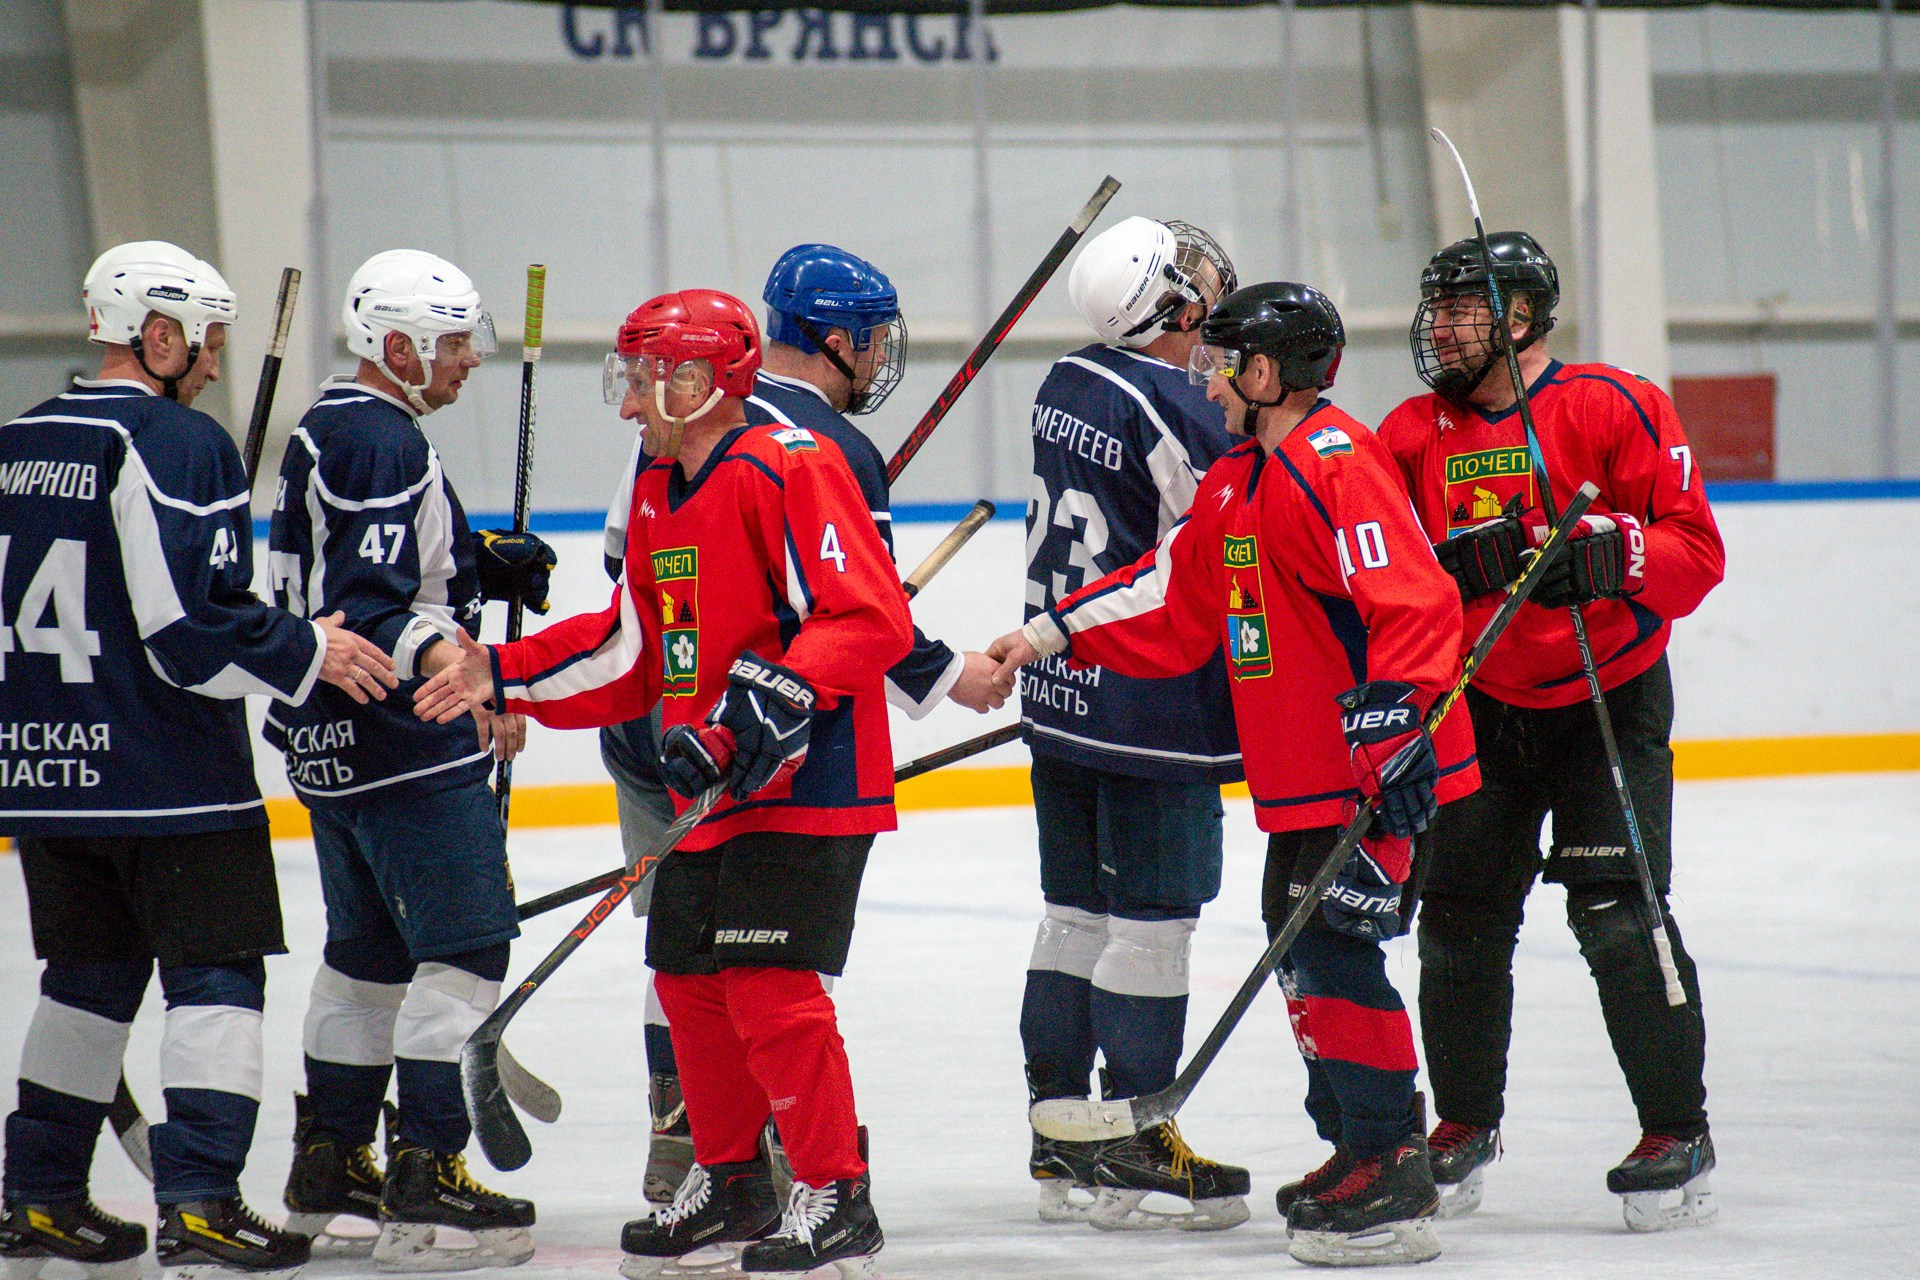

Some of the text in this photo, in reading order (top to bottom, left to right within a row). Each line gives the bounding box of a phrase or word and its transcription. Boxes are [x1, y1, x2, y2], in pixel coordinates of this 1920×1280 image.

[149, 289, 187, 299] BAUER
[374, 305, 410, 313] BAUER
[815, 299, 853, 307] BAU
[1126, 276, 1149, 311] BAUER
[1452, 452, 1526, 479] ПОЧЕП
[1670, 445, 1692, 492] 7
[358, 524, 406, 564] 47
[819, 522, 846, 573] 4
[1337, 521, 1390, 578] 10
[0, 535, 101, 683] 4
[1429, 672, 1470, 734] SUPER
[1341, 709, 1410, 733] UER
[1625, 810, 1641, 853] NEXUS
[1560, 846, 1627, 858] BAUER
[568, 856, 660, 939] VAPOR
[714, 930, 789, 944] BAUER
[823, 1231, 846, 1248] BAUER
